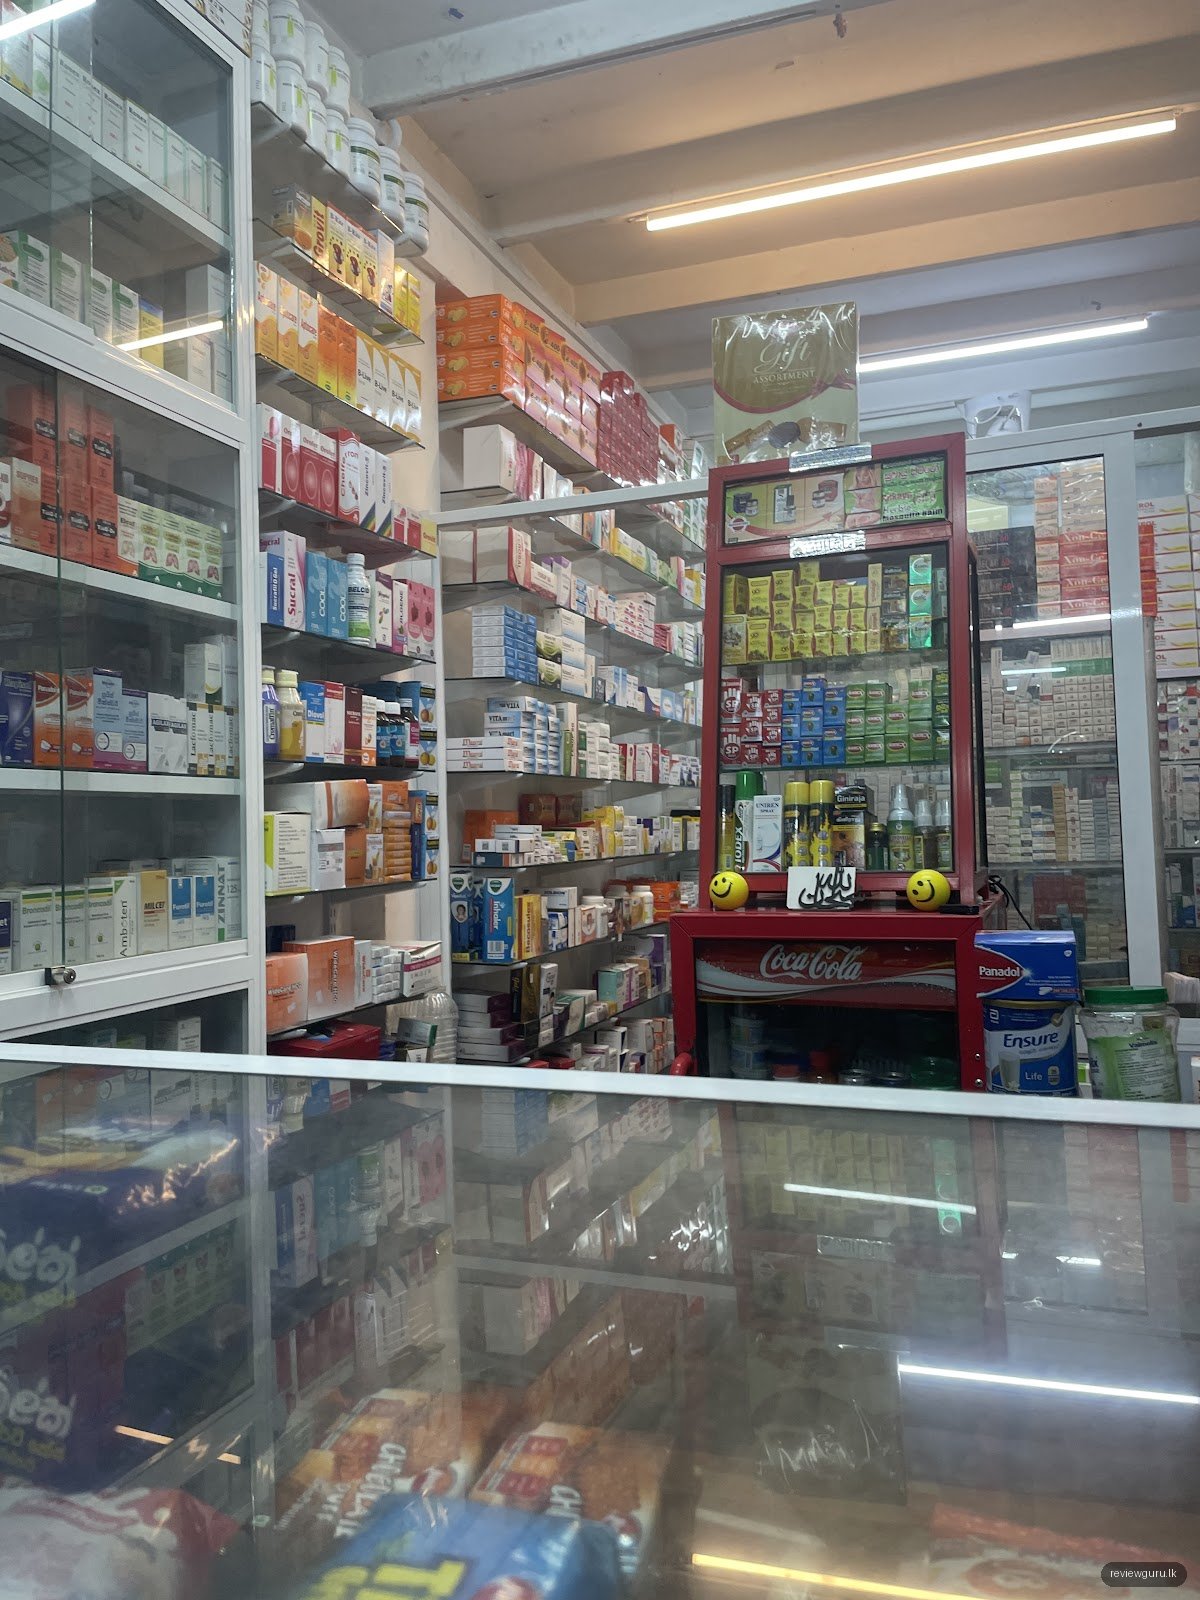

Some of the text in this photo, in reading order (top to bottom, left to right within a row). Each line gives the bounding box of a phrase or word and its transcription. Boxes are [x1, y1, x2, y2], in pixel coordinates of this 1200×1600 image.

[313, 209, 325, 257] Grovit
[753, 338, 812, 374] Gift
[753, 370, 816, 384] ASSORTMENT
[288, 572, 297, 616] Sucral
[726, 700, 739, 708] SP
[726, 746, 739, 754] SP
[836, 794, 866, 804] Giniraja
[735, 826, 743, 864] IODEX
[493, 901, 501, 930] Inhaler
[759, 943, 869, 981] Coca-Cola
[979, 966, 1020, 977] Panadol
[1003, 1032, 1059, 1048] Ensure
[1025, 1072, 1042, 1080] Life
